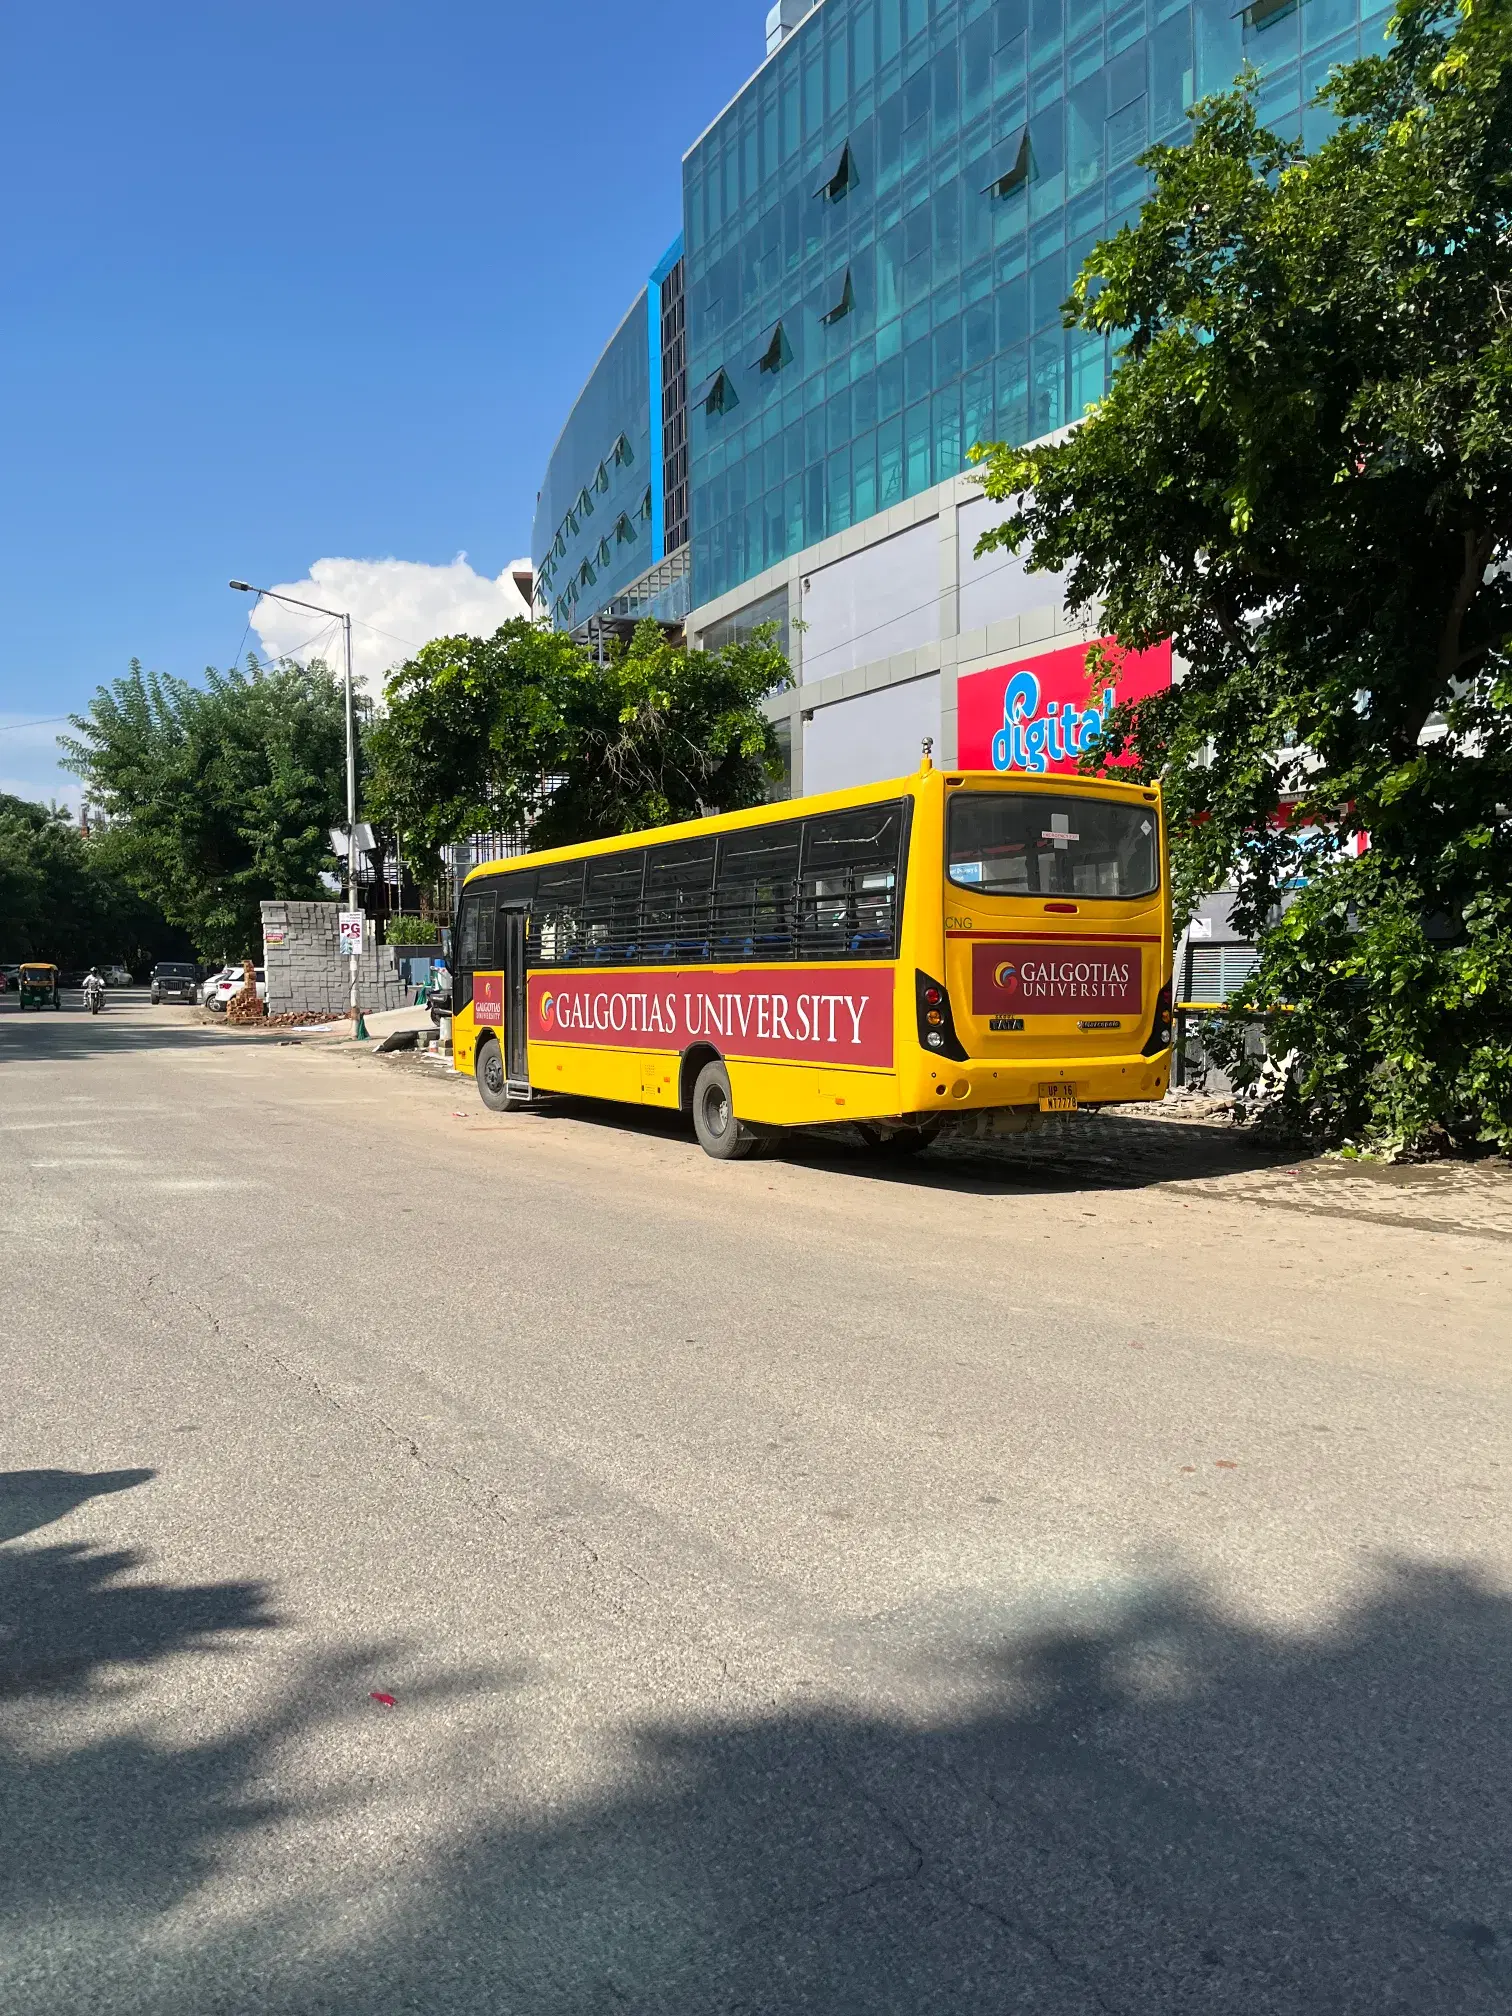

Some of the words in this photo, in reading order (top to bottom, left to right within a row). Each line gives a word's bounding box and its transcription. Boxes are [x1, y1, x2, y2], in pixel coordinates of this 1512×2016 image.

[945, 917, 972, 928] CNG
[341, 923, 361, 934] PG
[1020, 962, 1129, 982] GALGOTIAS
[1023, 983, 1128, 997] UNIVERSITY
[475, 1002, 501, 1012] GALGOTIAS
[476, 1012, 500, 1020] UNIVERSITY
[556, 992, 676, 1034] GALGOTIAS
[684, 993, 869, 1044] UNIVERSITY
[991, 1020, 1022, 1029] TATA
[1048, 1085, 1057, 1096] UP
[1064, 1085, 1072, 1096] 16
